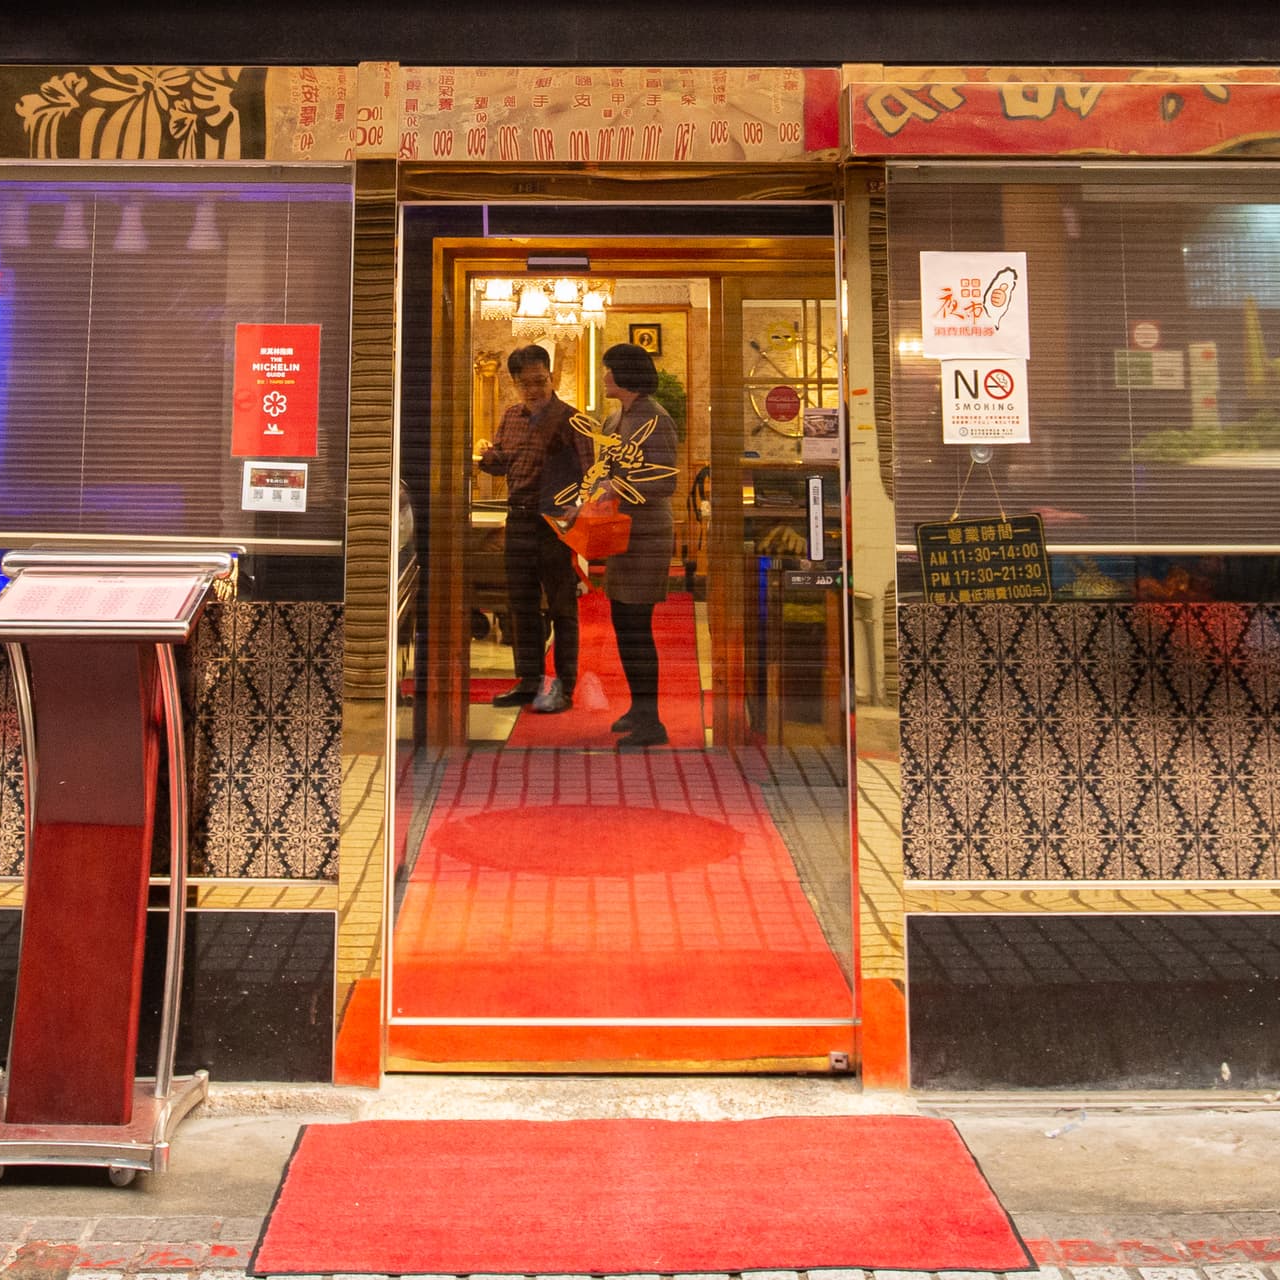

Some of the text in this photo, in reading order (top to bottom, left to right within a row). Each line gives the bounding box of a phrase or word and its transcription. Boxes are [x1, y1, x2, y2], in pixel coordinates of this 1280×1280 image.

[934, 287, 984, 326] 夜市
[252, 363, 300, 372] MICHELIN
[955, 402, 1015, 412] SMOKING
[948, 523, 1013, 545] 營業時間
[930, 543, 1039, 566] AM 11:30~14:00
[931, 563, 1041, 588] PM 17:30~21:30
